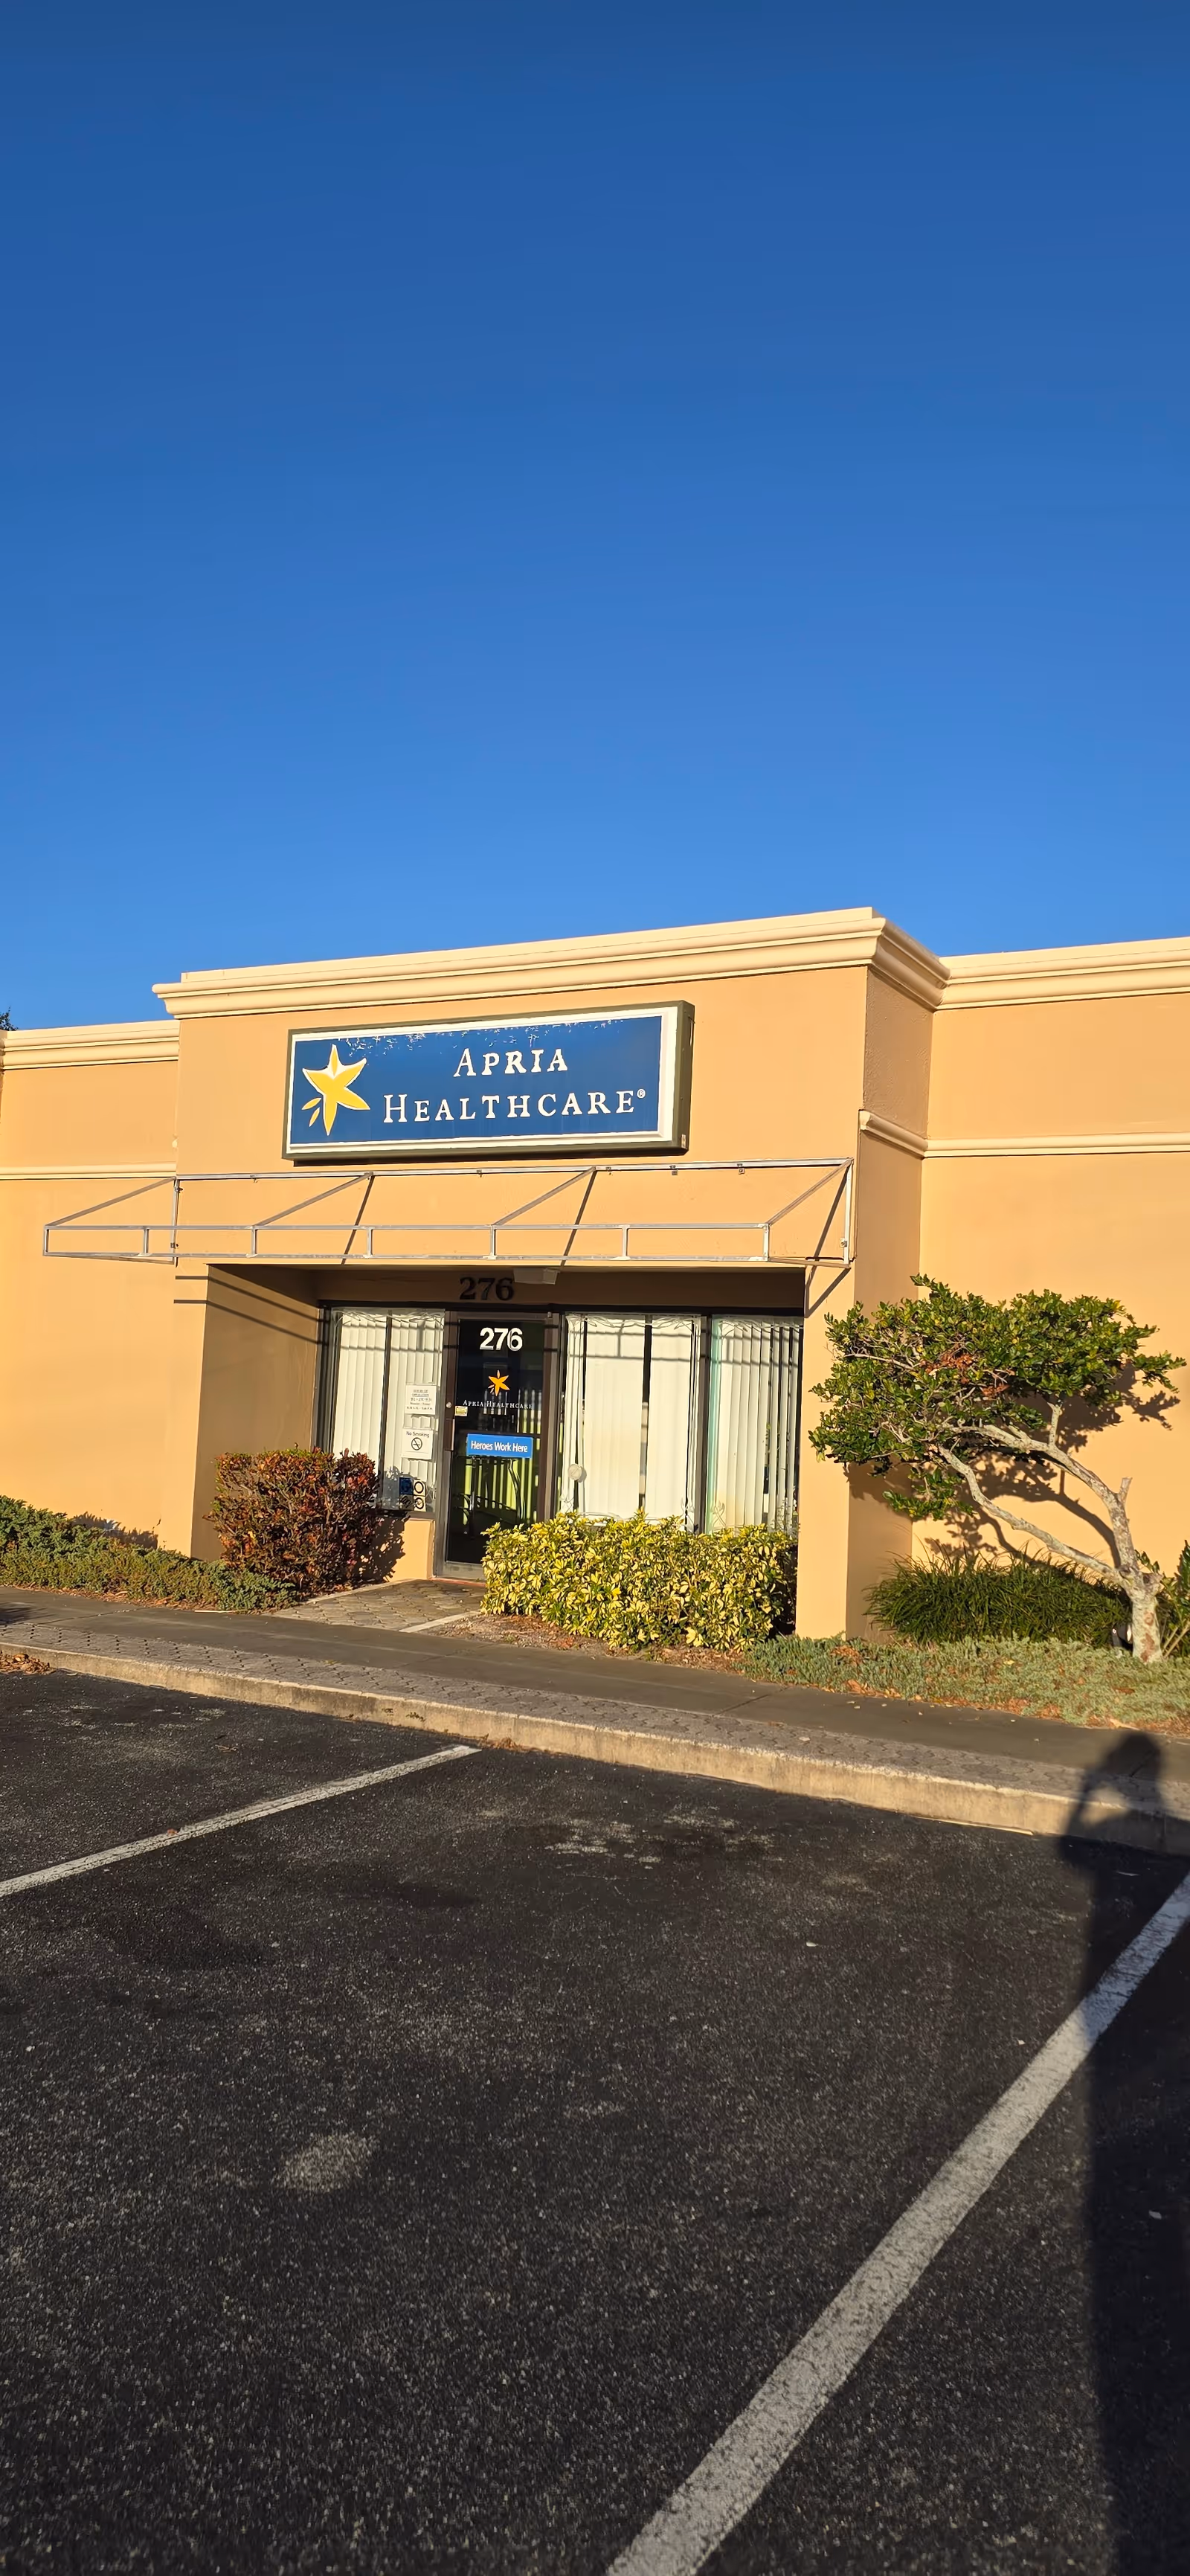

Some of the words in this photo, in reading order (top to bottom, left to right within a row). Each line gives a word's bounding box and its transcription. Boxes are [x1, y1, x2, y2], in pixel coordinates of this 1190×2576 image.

[453, 1047, 568, 1078] APRIA
[459, 1276, 515, 1301] 276
[479, 1327, 523, 1352] 276
[471, 1440, 493, 1451] Heroes
[494, 1442, 512, 1452] Work
[512, 1443, 528, 1453] Here
